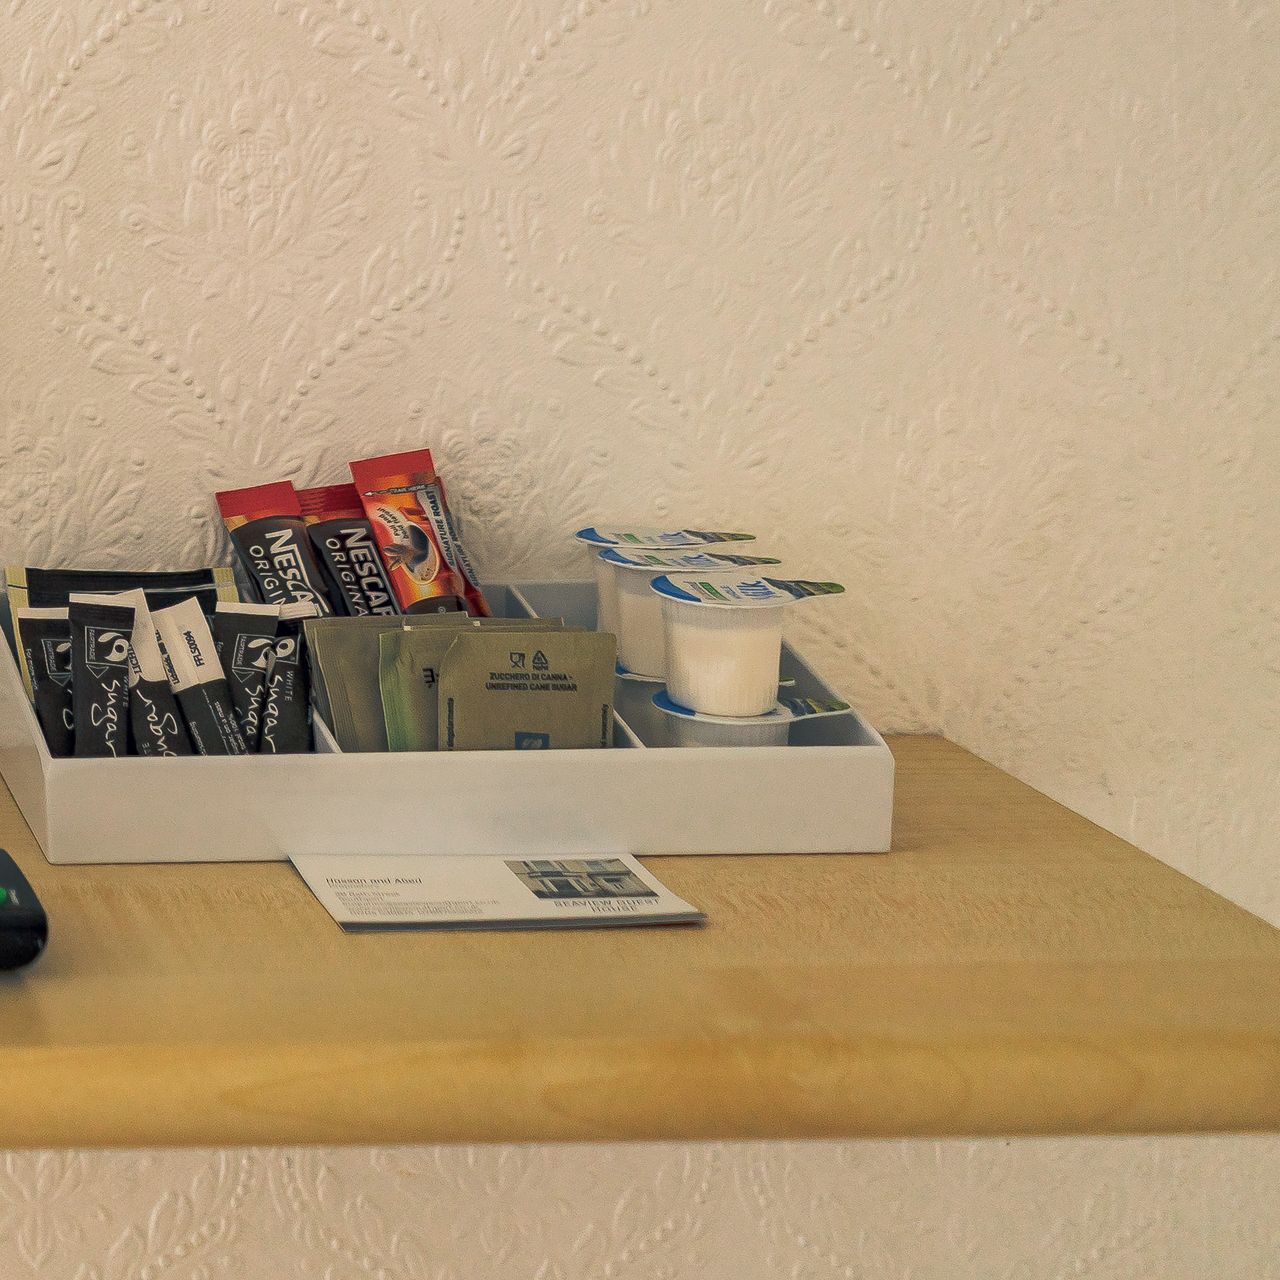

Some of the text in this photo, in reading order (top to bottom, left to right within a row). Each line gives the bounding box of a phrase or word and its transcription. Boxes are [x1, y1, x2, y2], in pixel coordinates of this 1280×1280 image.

[426, 490, 455, 567] SIGNATURE ROAST
[490, 673, 529, 681] ZUCCHERO
[541, 673, 569, 681] CANNA
[284, 671, 294, 702] WHITE
[485, 682, 578, 692] UNREFINED CANE SUGAR
[553, 899, 612, 907] SEAVIEW
